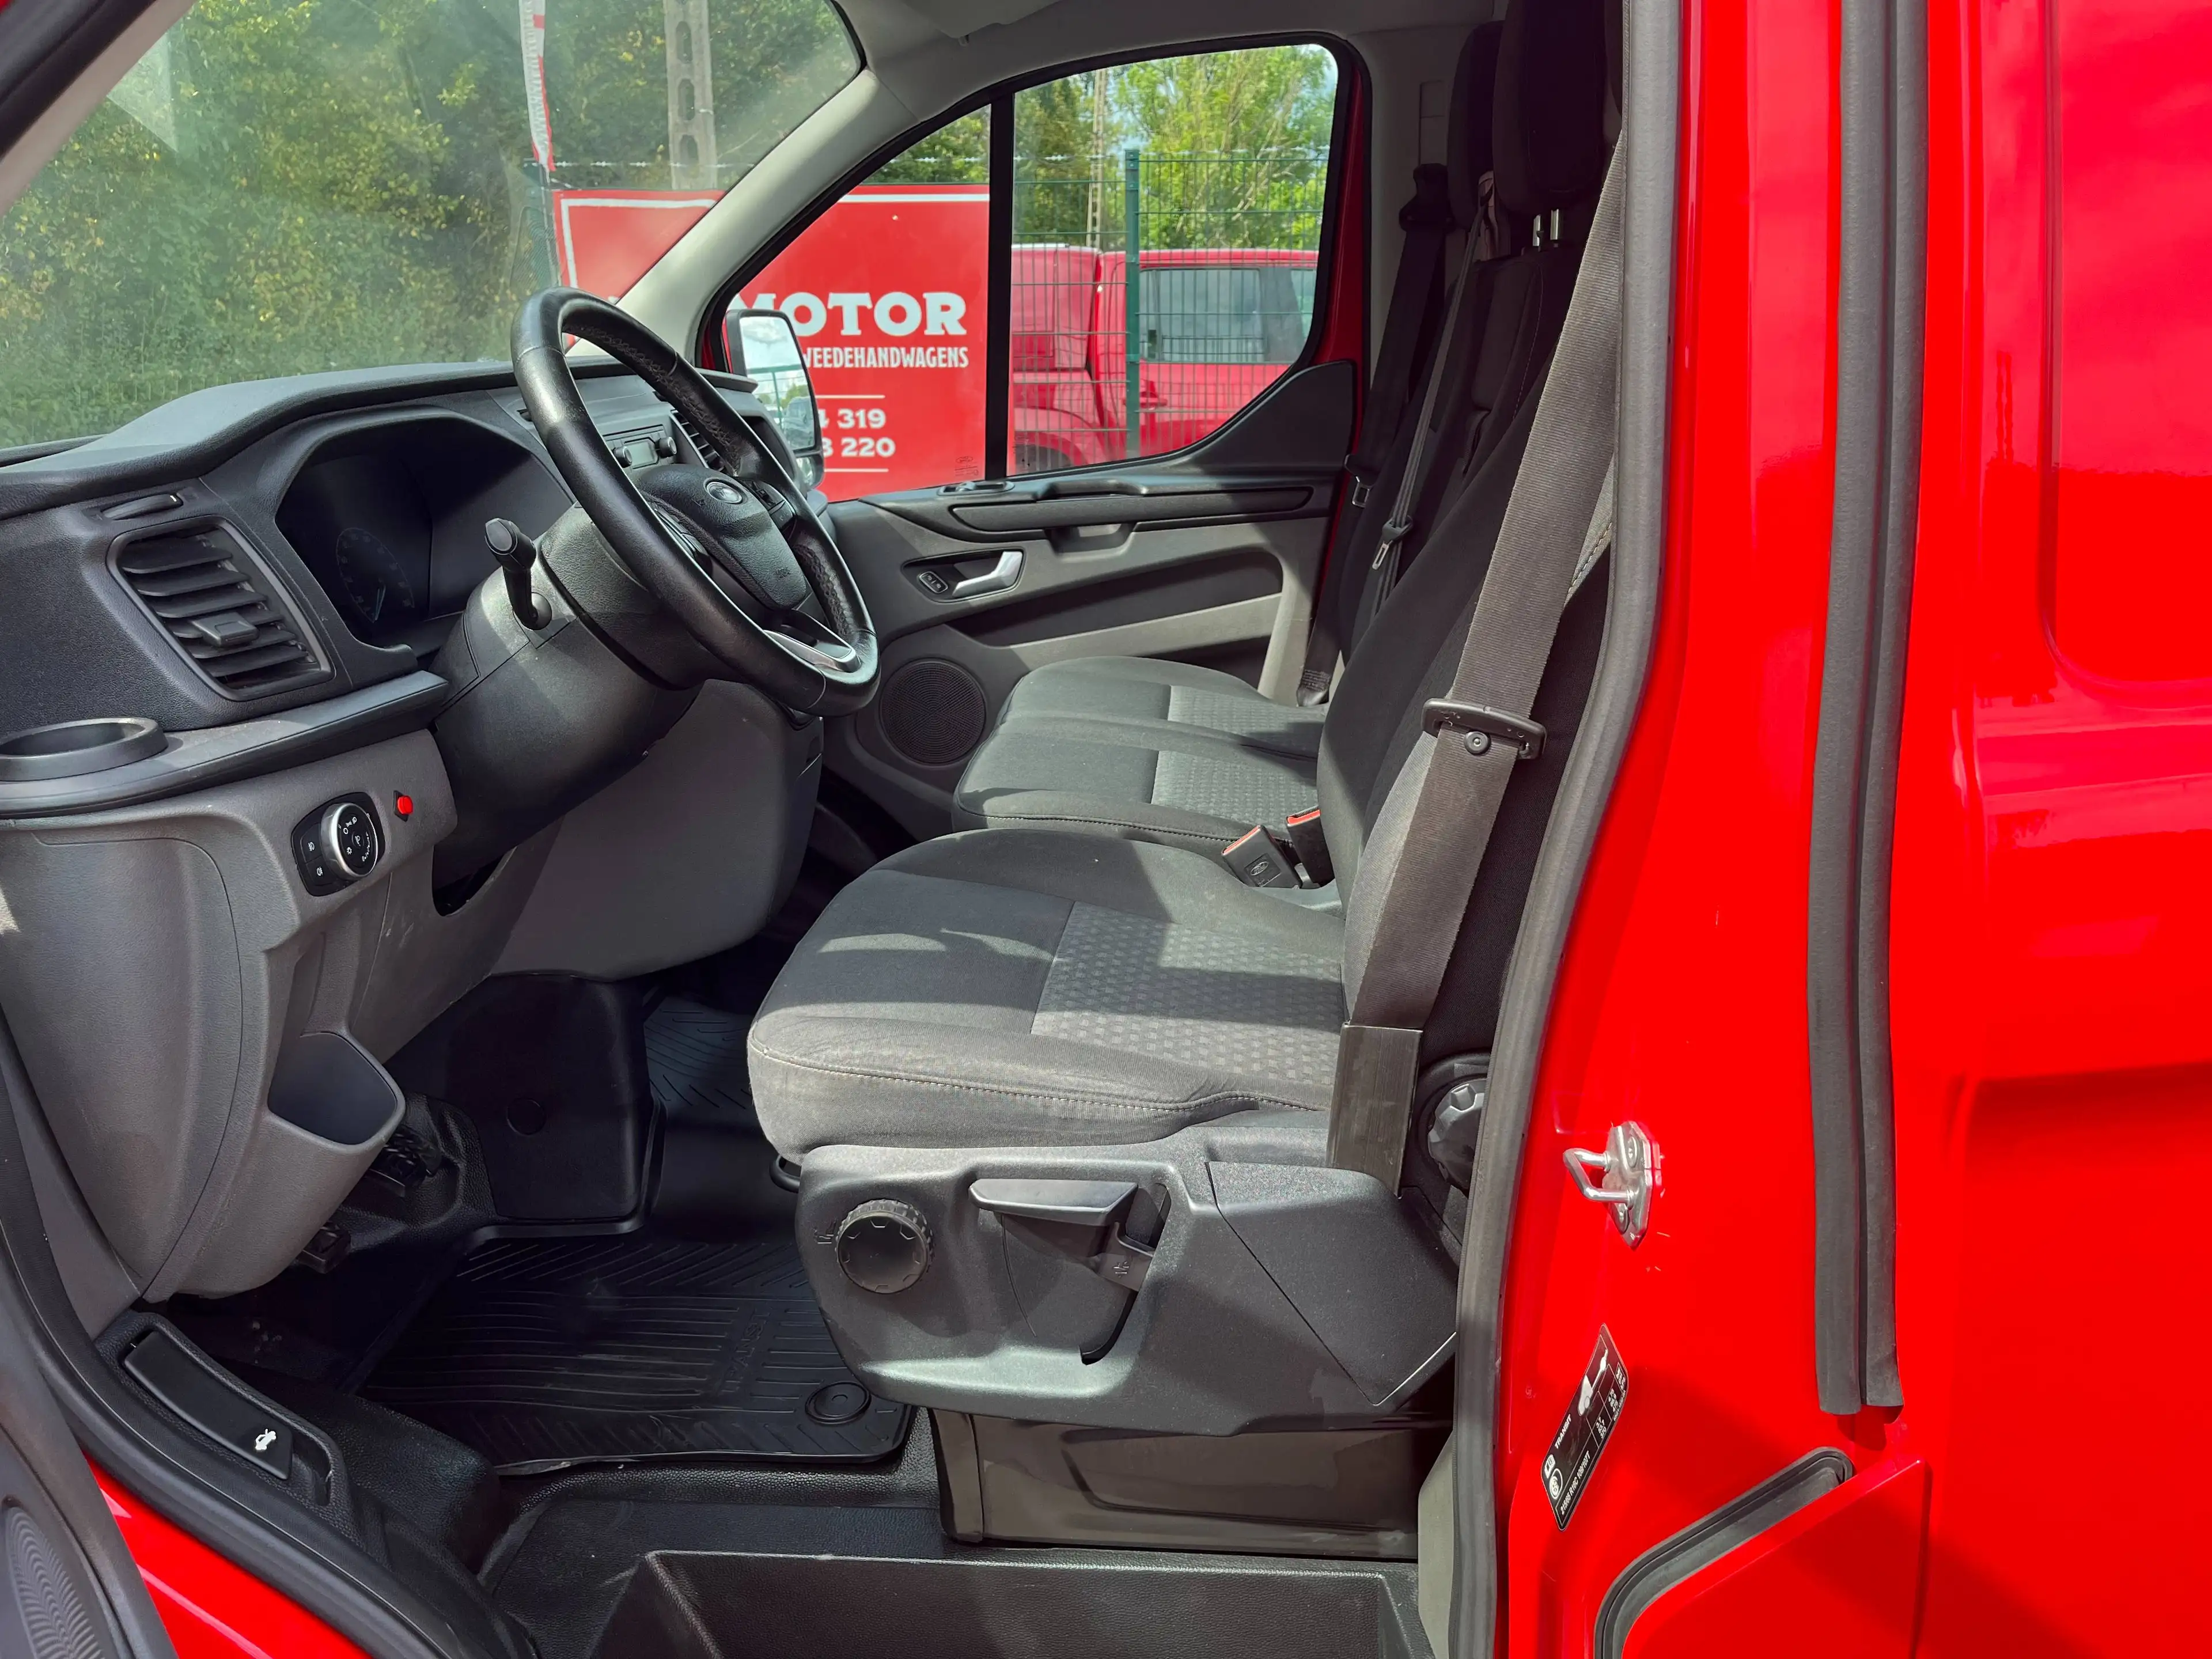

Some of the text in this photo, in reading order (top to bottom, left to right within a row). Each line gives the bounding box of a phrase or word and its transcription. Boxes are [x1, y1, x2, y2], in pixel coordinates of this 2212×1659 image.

[837, 408, 886, 429] 319
[840, 437, 896, 459] 220
[1555, 1414, 1571, 1449] TRANSIT
[1569, 1476, 1579, 1495] R16C
